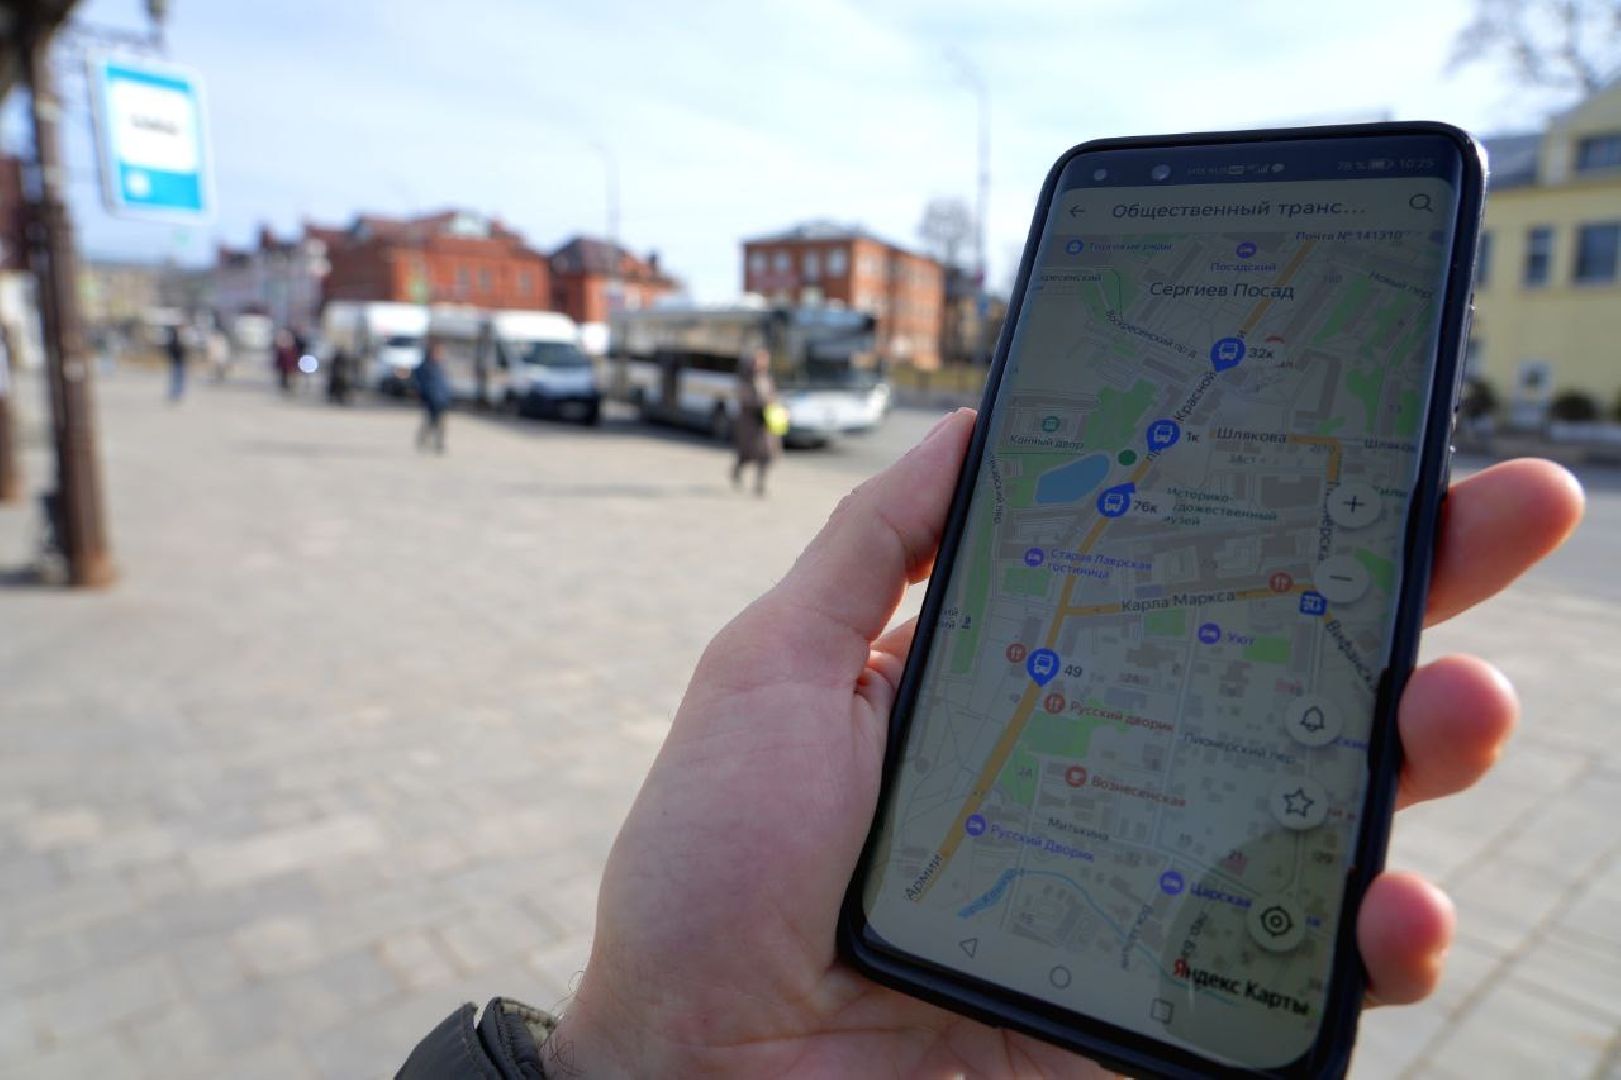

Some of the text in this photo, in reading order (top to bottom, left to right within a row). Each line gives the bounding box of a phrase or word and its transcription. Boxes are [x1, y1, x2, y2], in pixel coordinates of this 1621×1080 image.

[1112, 201, 1366, 219] Общественный транс...
[1149, 281, 1295, 301] Сергиев Посад
[1122, 592, 1236, 612] Карла Маркса
[1065, 664, 1083, 679] 49
[1071, 700, 1123, 722] Русский
[990, 824, 1096, 864] Русский Дворик
[1174, 957, 1311, 1017] Яндекс Карты
